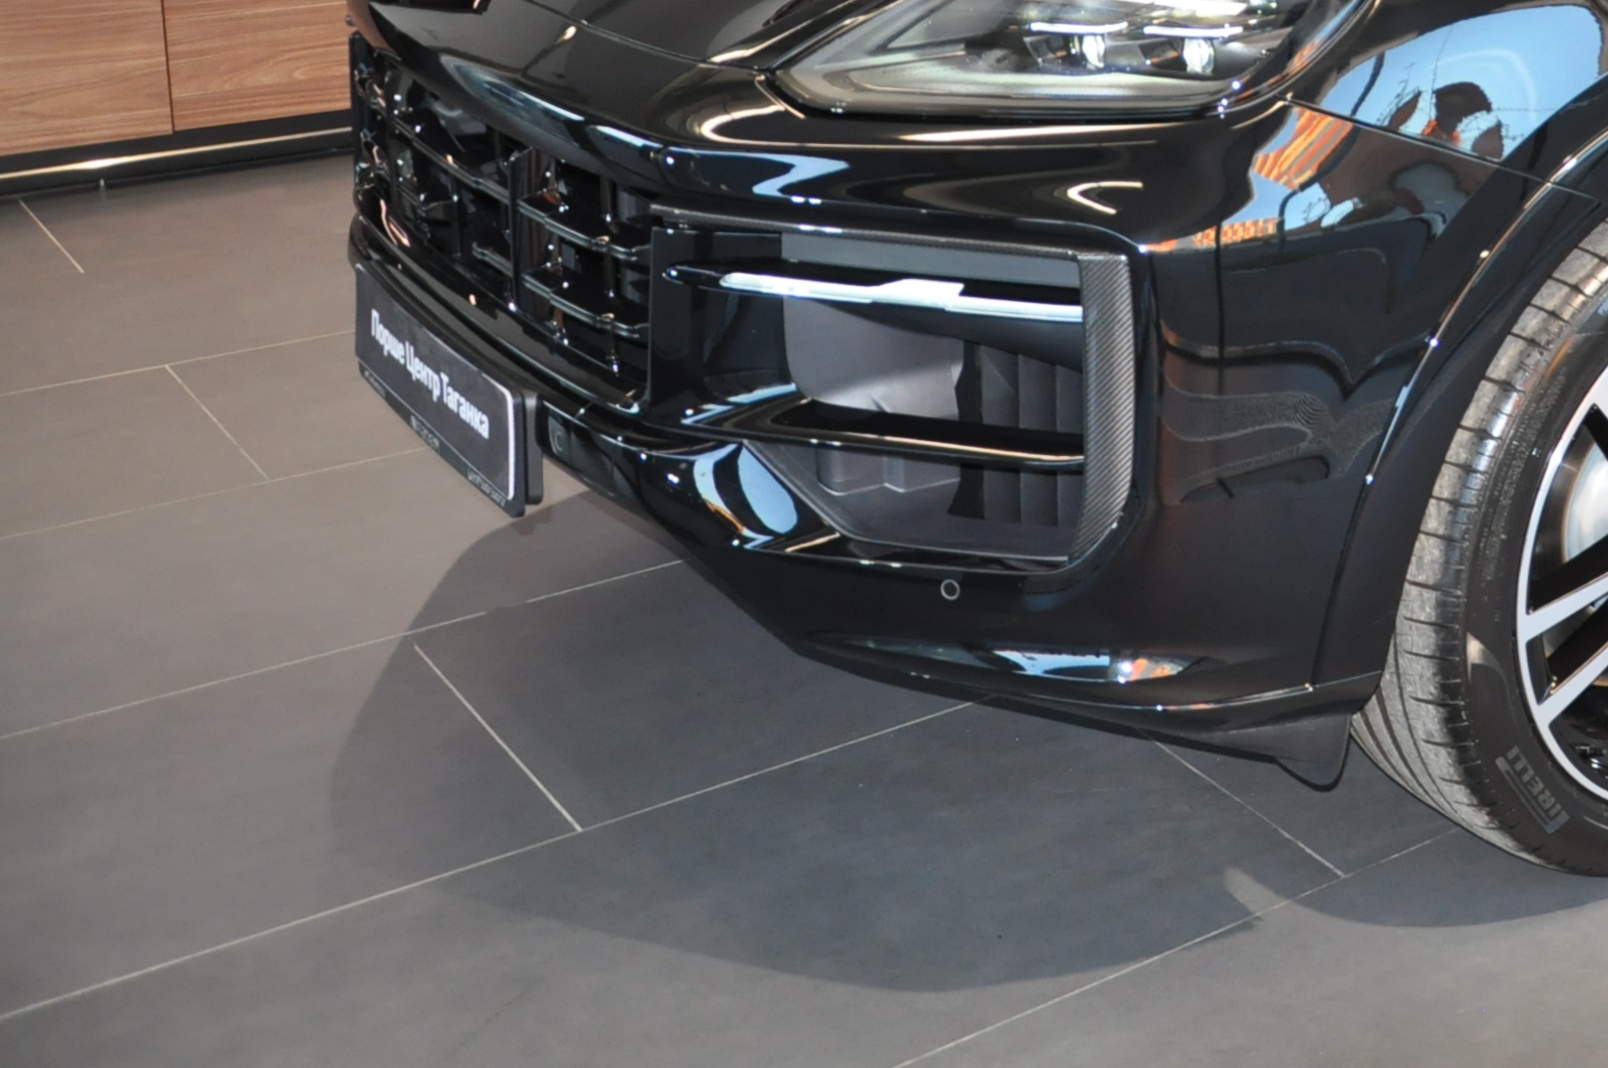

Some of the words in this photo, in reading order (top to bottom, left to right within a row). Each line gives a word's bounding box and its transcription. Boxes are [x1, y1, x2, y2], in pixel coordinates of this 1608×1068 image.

[370, 309, 405, 365] Порше
[404, 340, 440, 402] Центр
[440, 371, 490, 440] Таганка
[1495, 745, 1570, 834] PIRELLI
